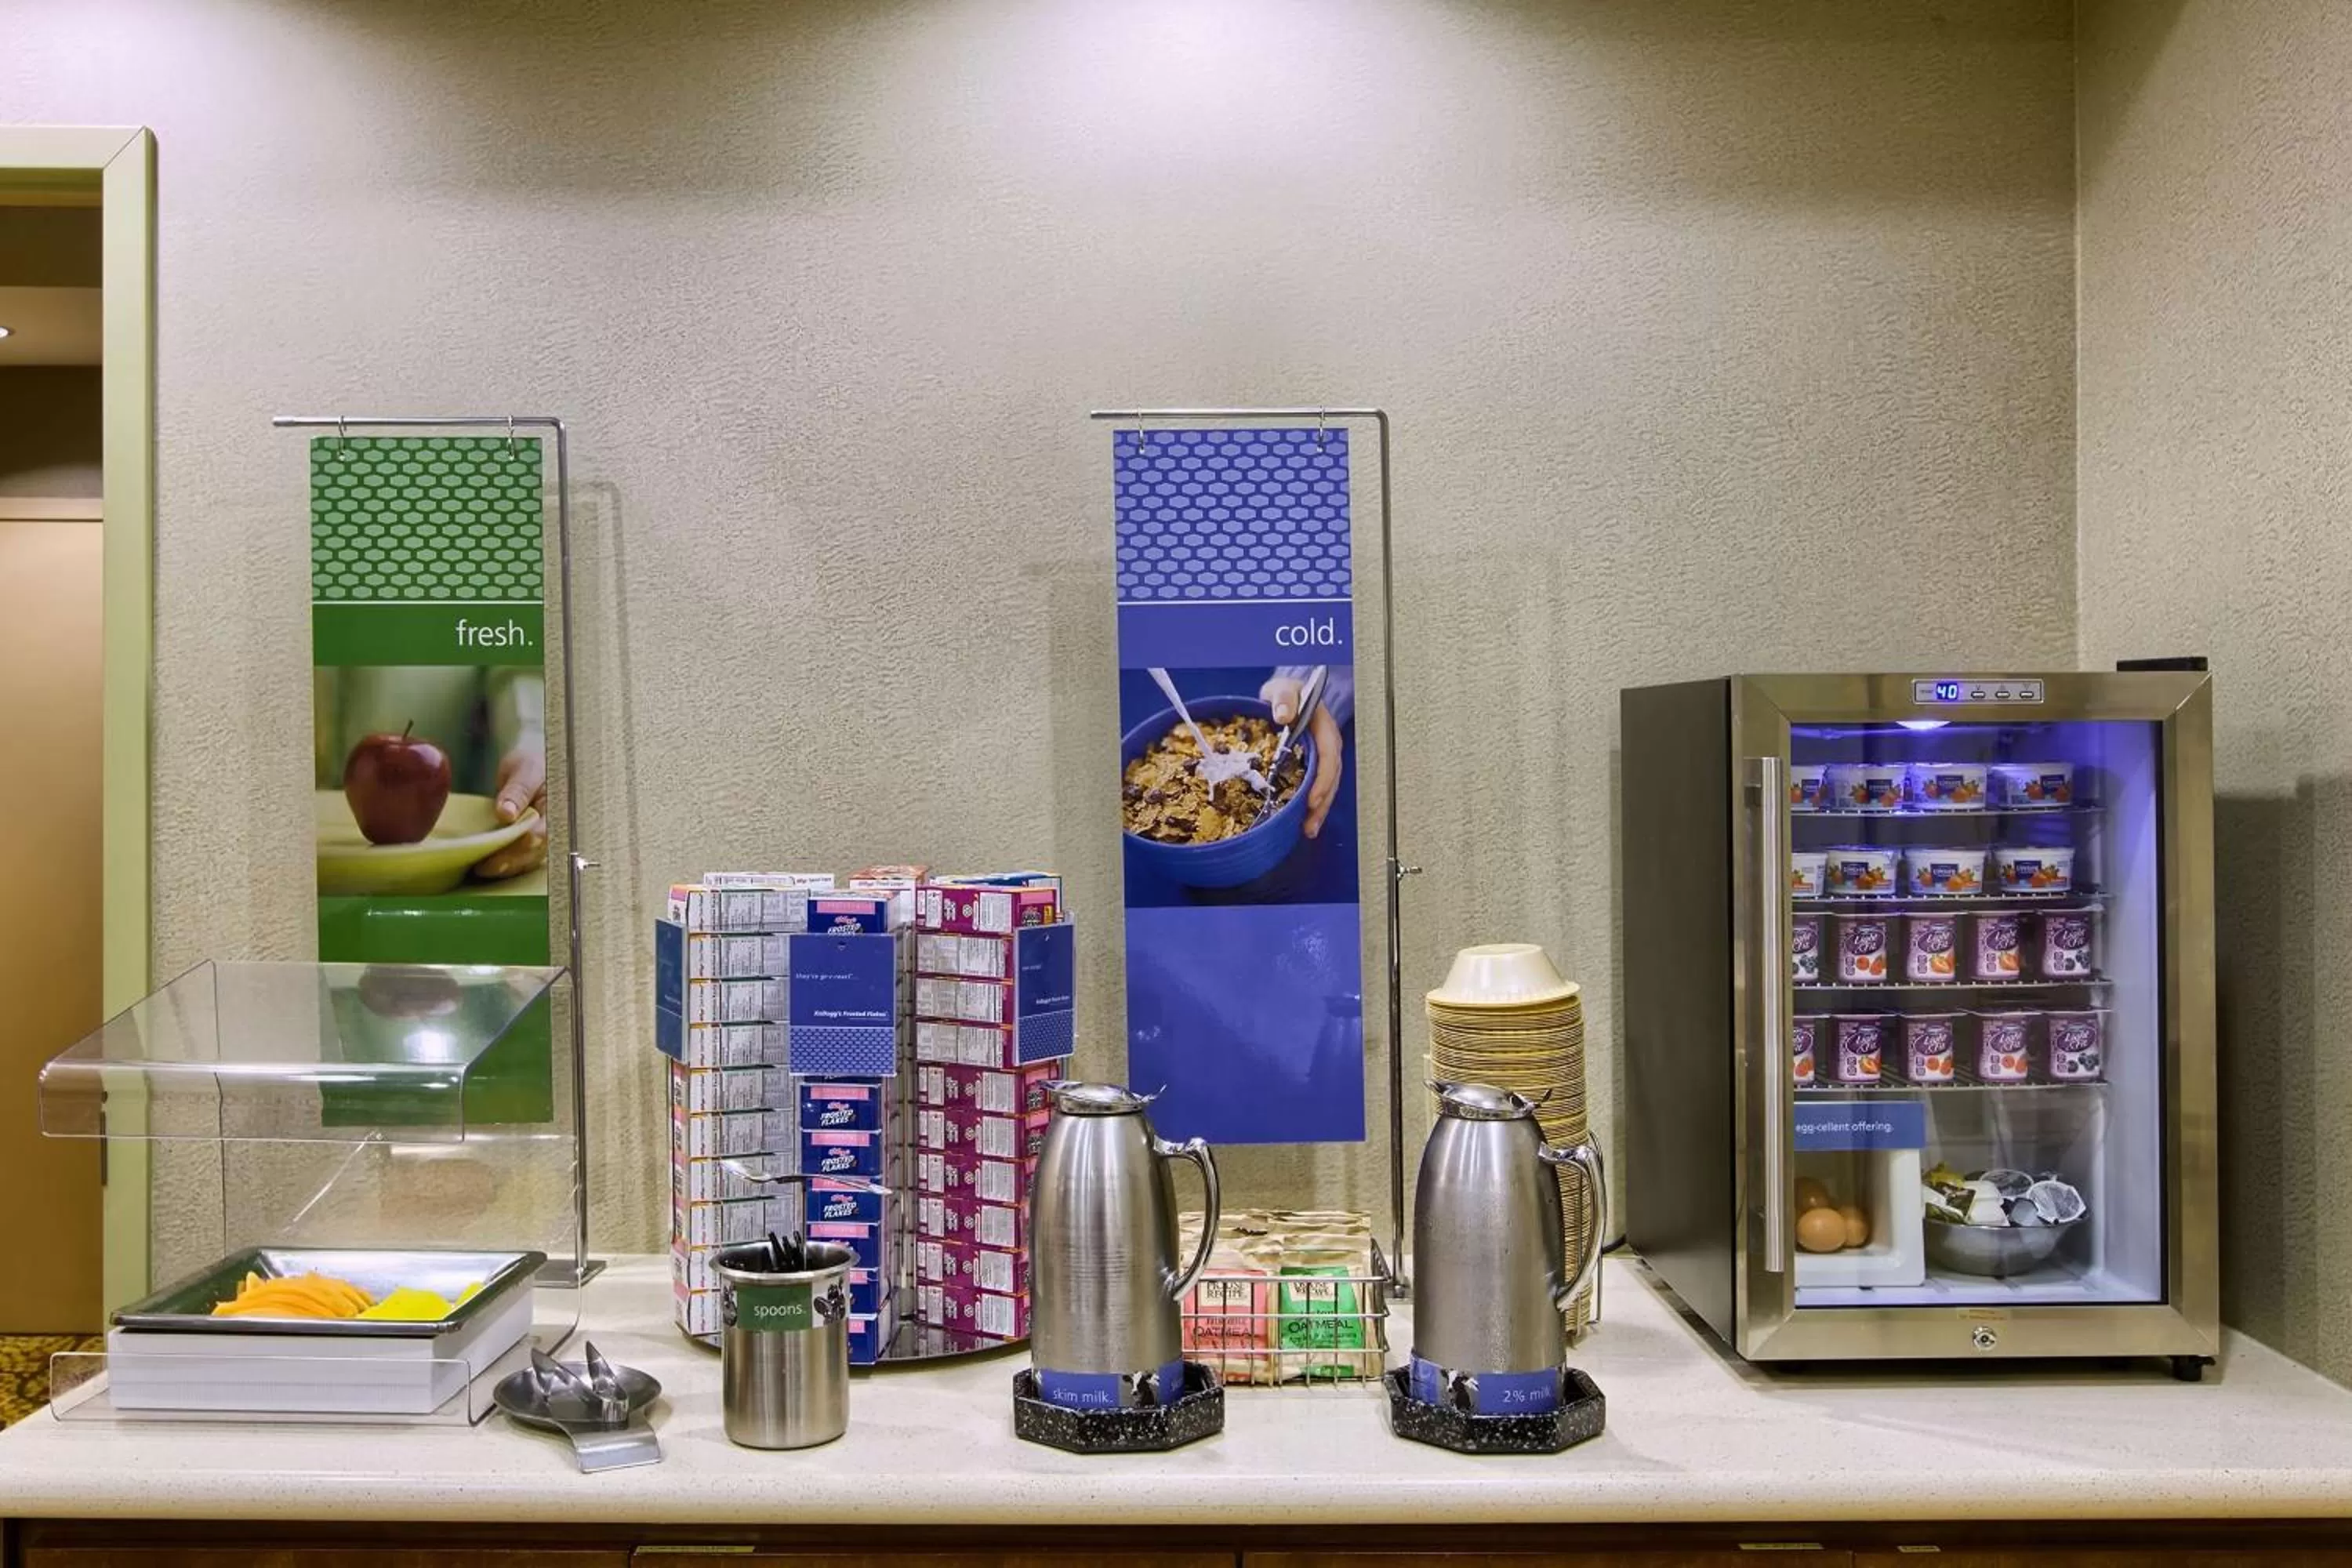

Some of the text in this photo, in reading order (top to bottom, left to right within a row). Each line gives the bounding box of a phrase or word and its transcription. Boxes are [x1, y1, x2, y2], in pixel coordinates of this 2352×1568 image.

[456, 618, 534, 647] fresh.
[1276, 617, 1343, 646] cold.
[1937, 685, 1957, 699] 40
[753, 1304, 807, 1319] spoons.
[1053, 1387, 1079, 1403] skim
[1503, 1390, 1526, 1403] 2%
